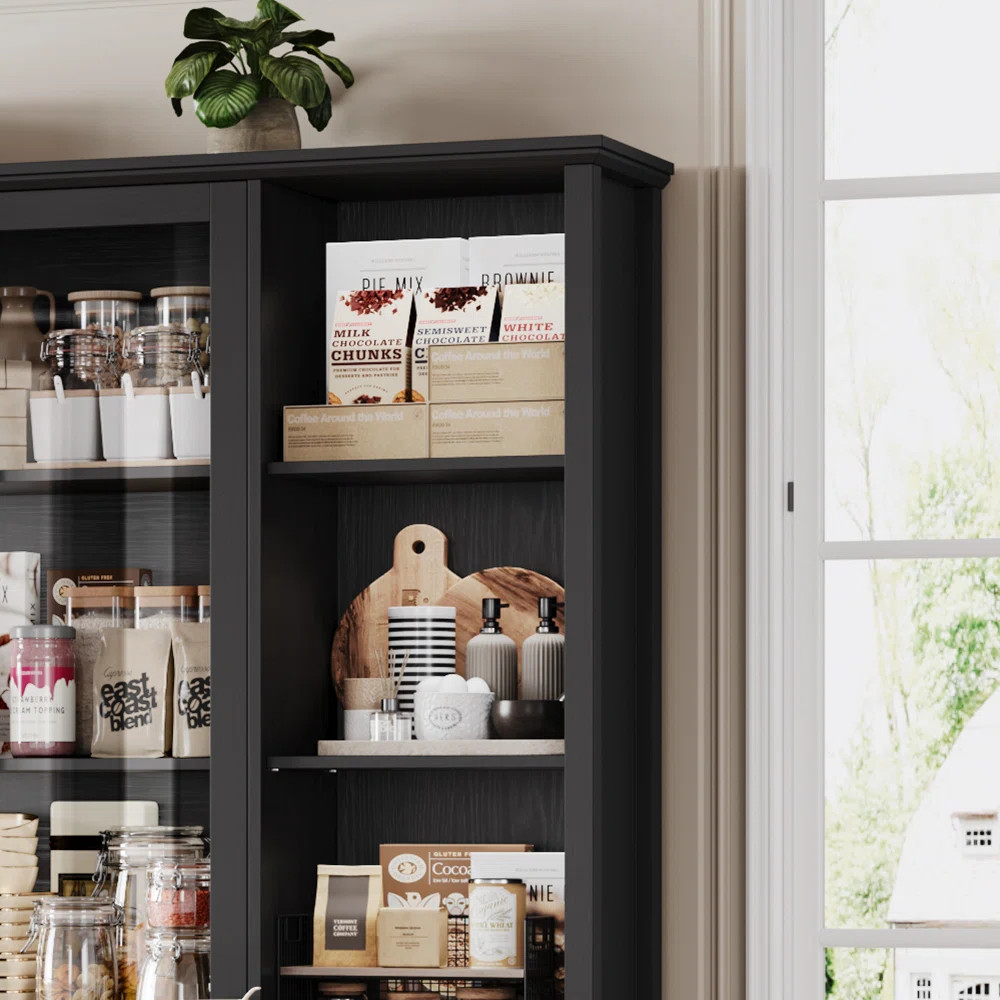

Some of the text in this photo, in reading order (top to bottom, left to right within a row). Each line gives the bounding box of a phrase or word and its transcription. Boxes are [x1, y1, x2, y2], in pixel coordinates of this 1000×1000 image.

[362, 276, 423, 295] PIE MIX
[334, 329, 371, 338] MILK
[417, 326, 487, 335] SEMISWEET
[504, 323, 553, 332] WHITE
[332, 339, 403, 348] CHOCOLATE
[416, 335, 486, 345] CHOCOLATE
[502, 333, 565, 342] CHOCOLAT
[331, 349, 402, 361] CHUNKS
[288, 413, 318, 424] Coffee
[320, 411, 355, 422] Around
[375, 410, 404, 421] World
[100, 672, 149, 701] east
[100, 687, 157, 718] coast
[110, 707, 152, 732] blend
[187, 711, 211, 730] ble
